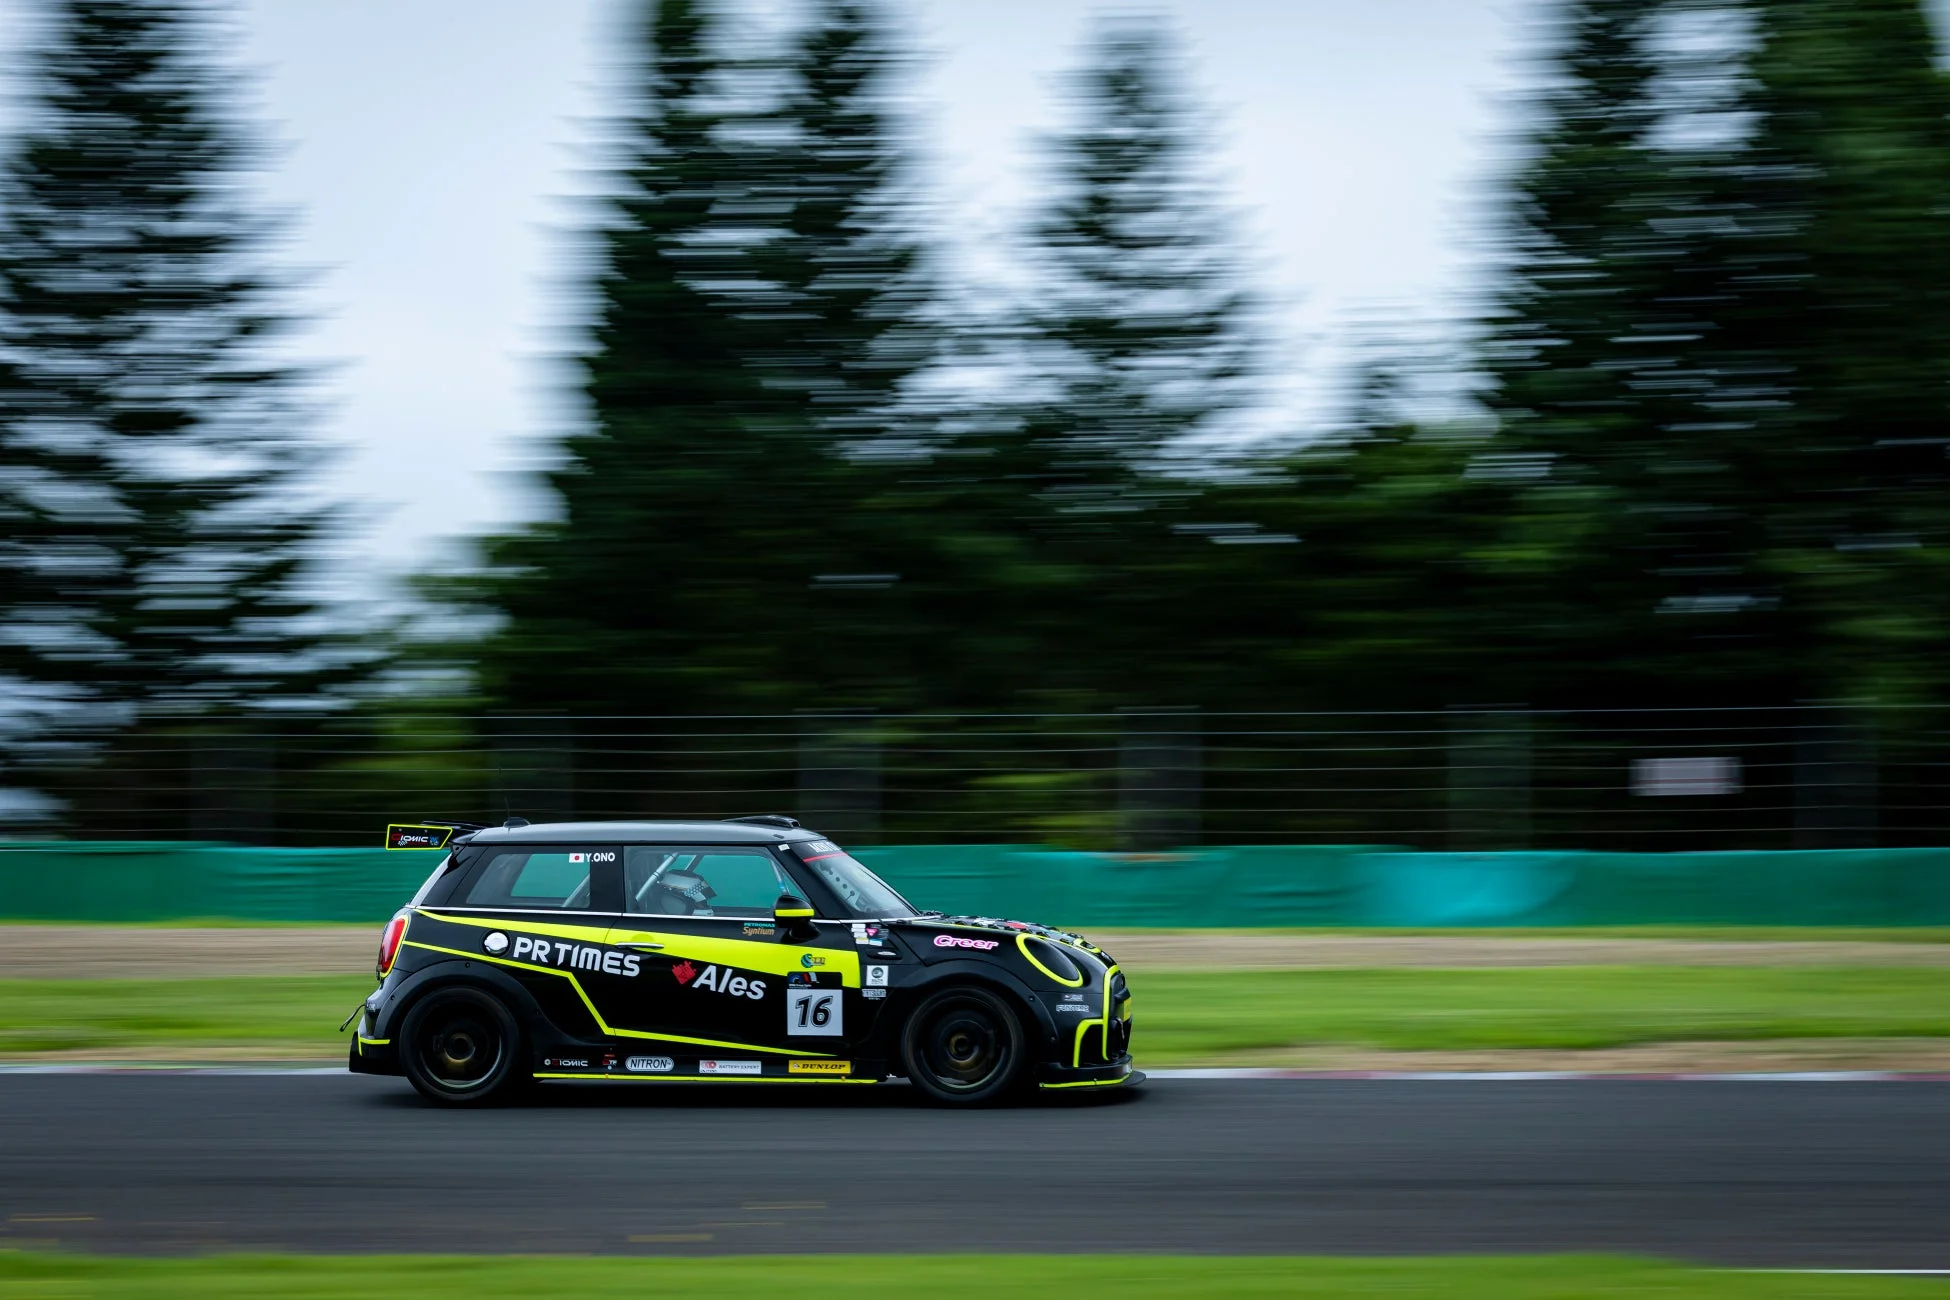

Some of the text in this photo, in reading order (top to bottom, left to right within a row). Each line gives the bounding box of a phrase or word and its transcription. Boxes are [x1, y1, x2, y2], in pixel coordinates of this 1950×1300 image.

[585, 852, 616, 863] Y.ONO
[933, 934, 999, 950] Creer
[513, 936, 641, 977] PR TIMES
[692, 964, 767, 1000] Ales
[795, 995, 834, 1028] 16
[630, 1059, 668, 1069] NITRON
